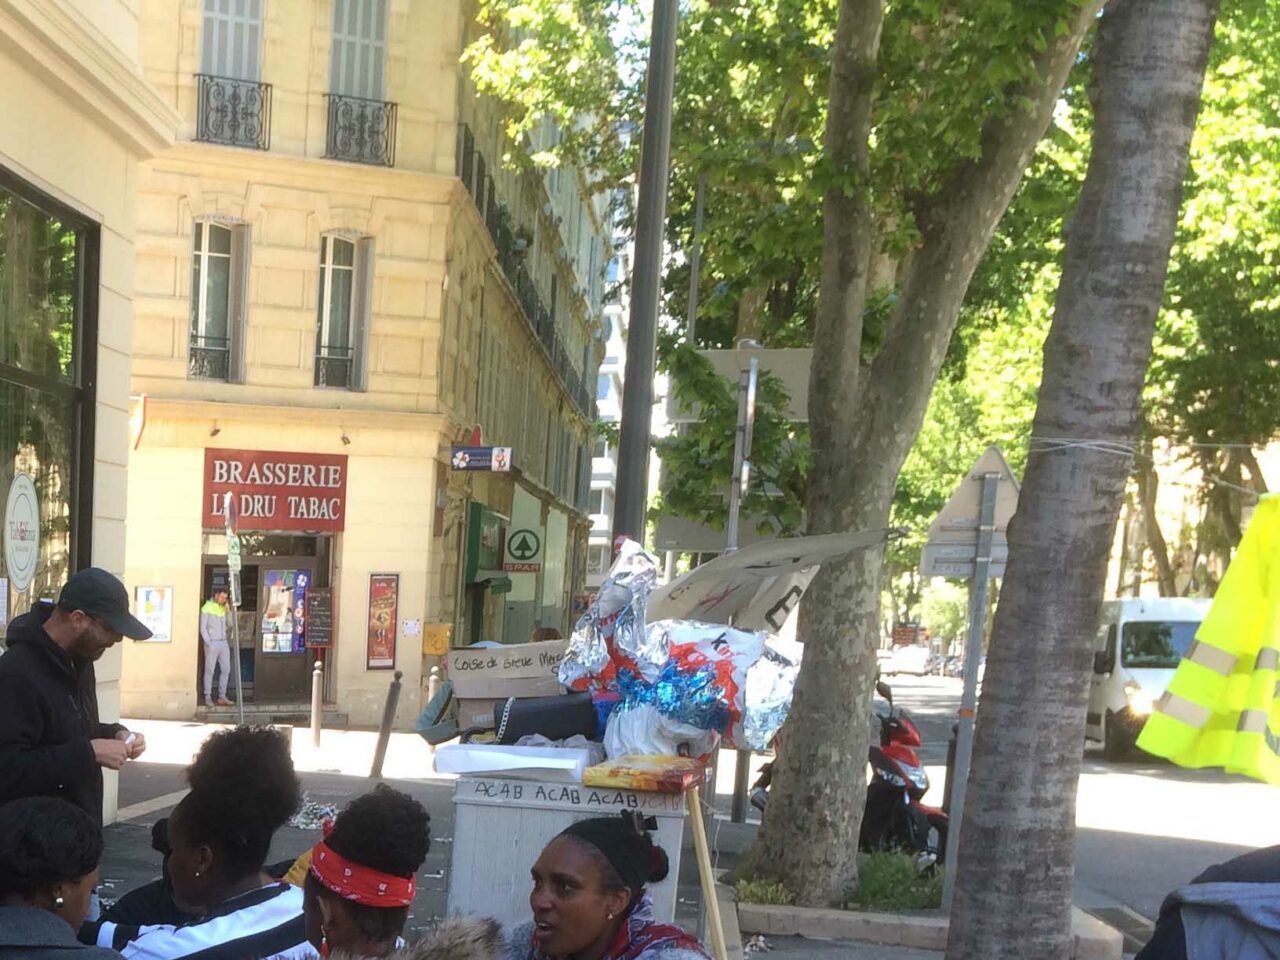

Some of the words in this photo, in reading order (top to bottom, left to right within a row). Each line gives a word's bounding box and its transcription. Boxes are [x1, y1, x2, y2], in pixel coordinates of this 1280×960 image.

[213, 460, 341, 488] BRASSERIE
[240, 494, 277, 517] DRU
[287, 496, 341, 519] TABAC
[505, 563, 540, 572] SPAR
[475, 782, 523, 800] ACAB
[535, 785, 581, 804] ACAB
[587, 791, 638, 809] ACAB
